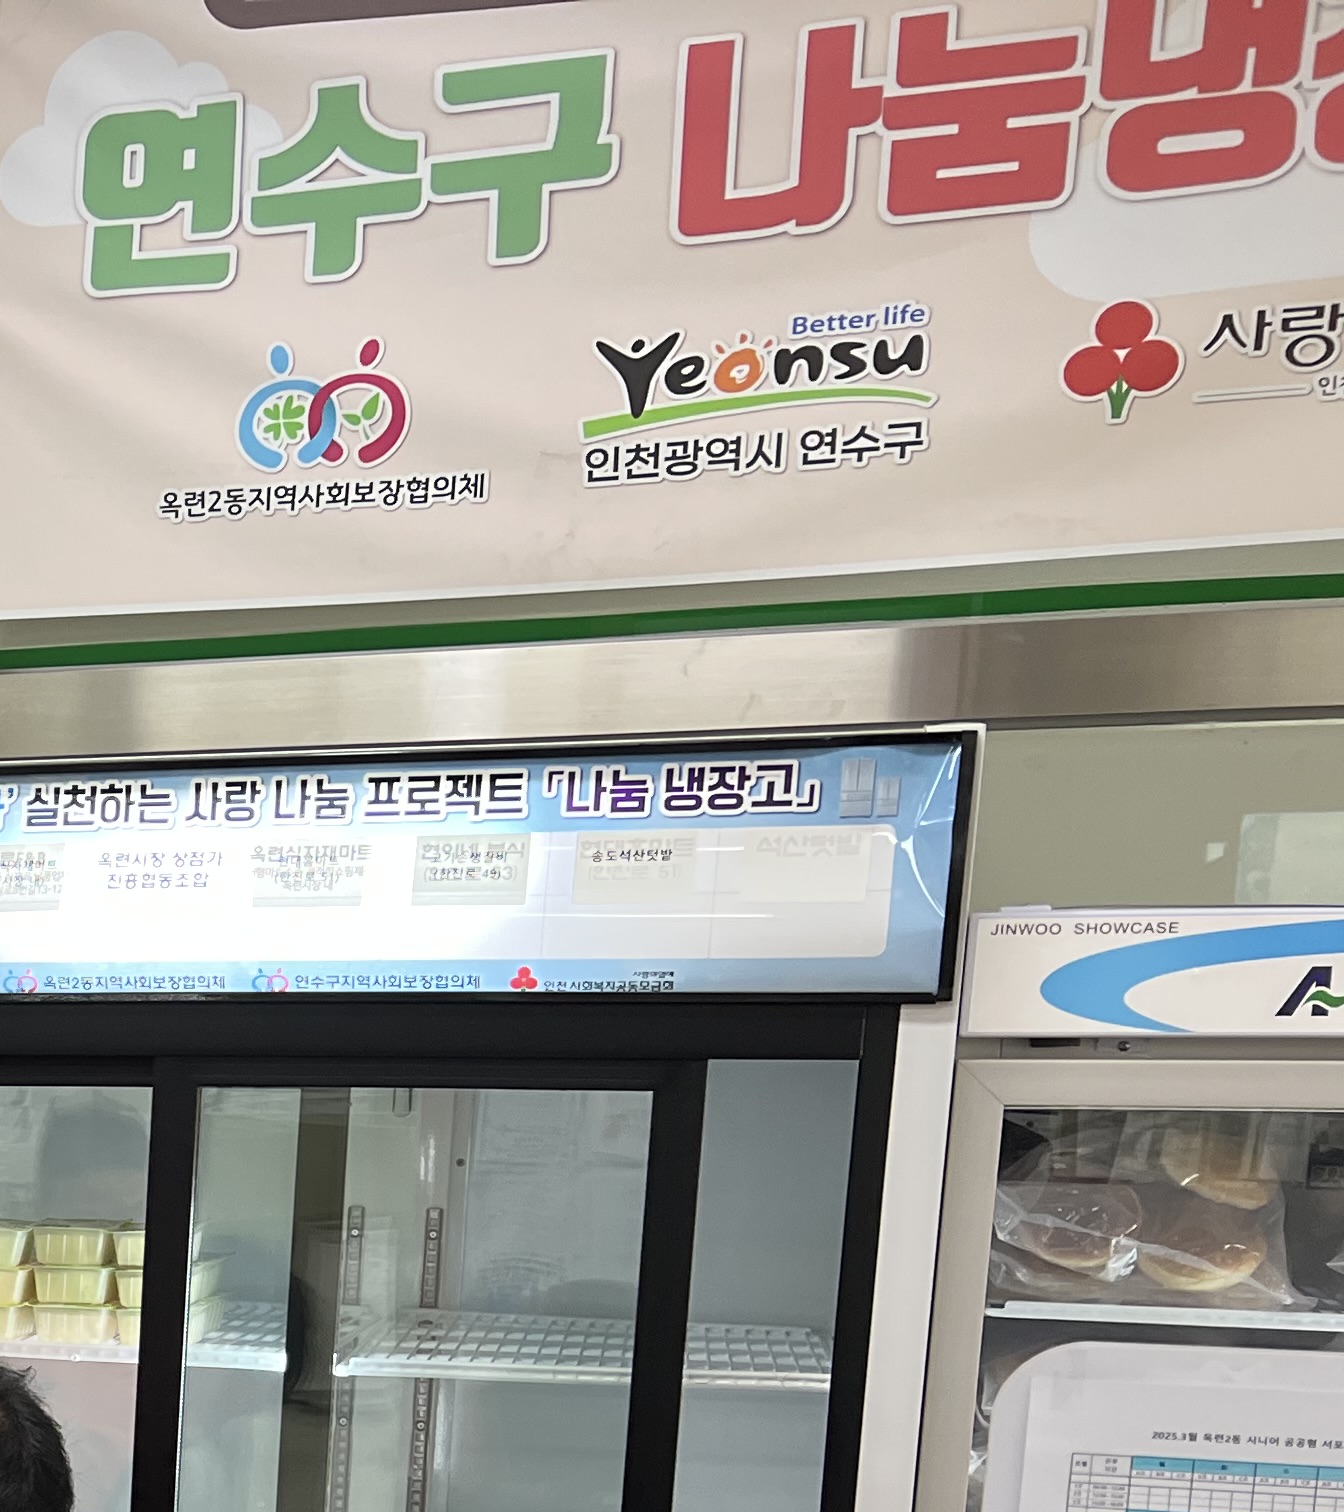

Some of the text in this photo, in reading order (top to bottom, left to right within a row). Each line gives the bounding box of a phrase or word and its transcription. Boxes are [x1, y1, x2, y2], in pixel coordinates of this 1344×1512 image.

[83, 0, 1344, 295] 연수구 나눔냉
[791, 303, 926, 336] Better life
[595, 331, 925, 419] Yeonsu
[584, 421, 924, 483] 인천광역시 연수구
[158, 473, 487, 521] 옥련2동지역사회보장협의체
[26, 780, 173, 827] 실천하는
[185, 779, 260, 822] 사랑
[275, 777, 348, 819] 나눔
[367, 770, 525, 816] 프로젝트
[97, 850, 223, 868] 옥련시장 상점가
[591, 849, 673, 862] 송도석산텃밭
[990, 921, 1180, 936] JINWOO SHOWCASE
[43, 974, 226, 990] 옥련2동지역사회보장협의체
[294, 974, 481, 990] 연수구지역사회보장협의체
[1247, 1436, 1280, 1446] 시니어
